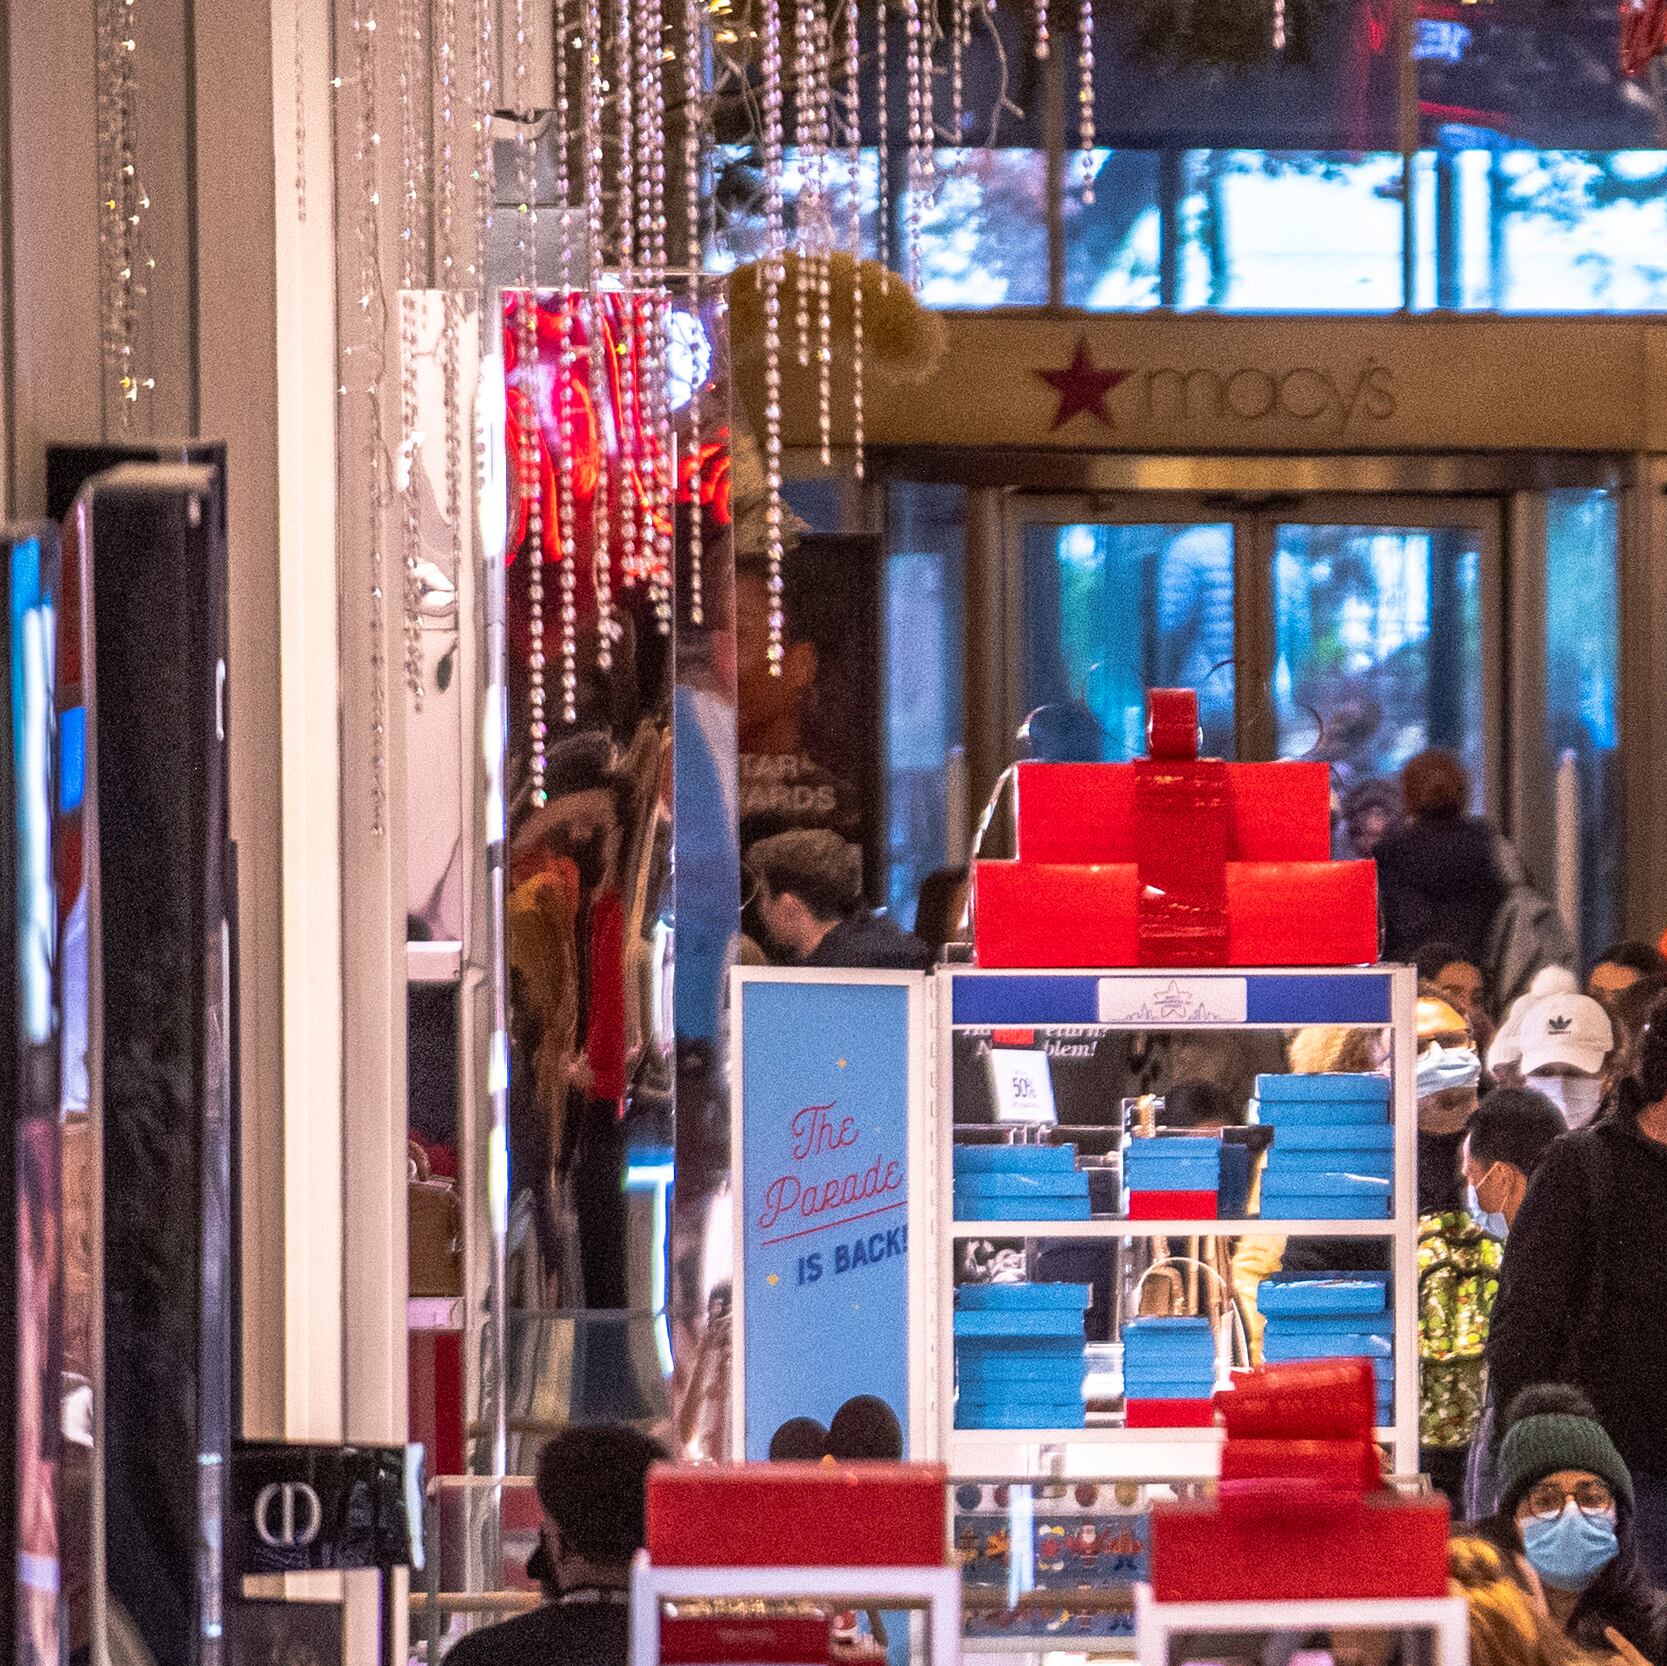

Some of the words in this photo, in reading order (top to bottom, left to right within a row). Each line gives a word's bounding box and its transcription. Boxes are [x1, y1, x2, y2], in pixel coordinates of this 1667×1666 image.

[1143, 357, 1397, 437] macy's
[791, 1100, 859, 1160] The
[759, 1154, 904, 1229] Parade
[797, 1253, 823, 1285] IS
[834, 1224, 908, 1275] BACK!
